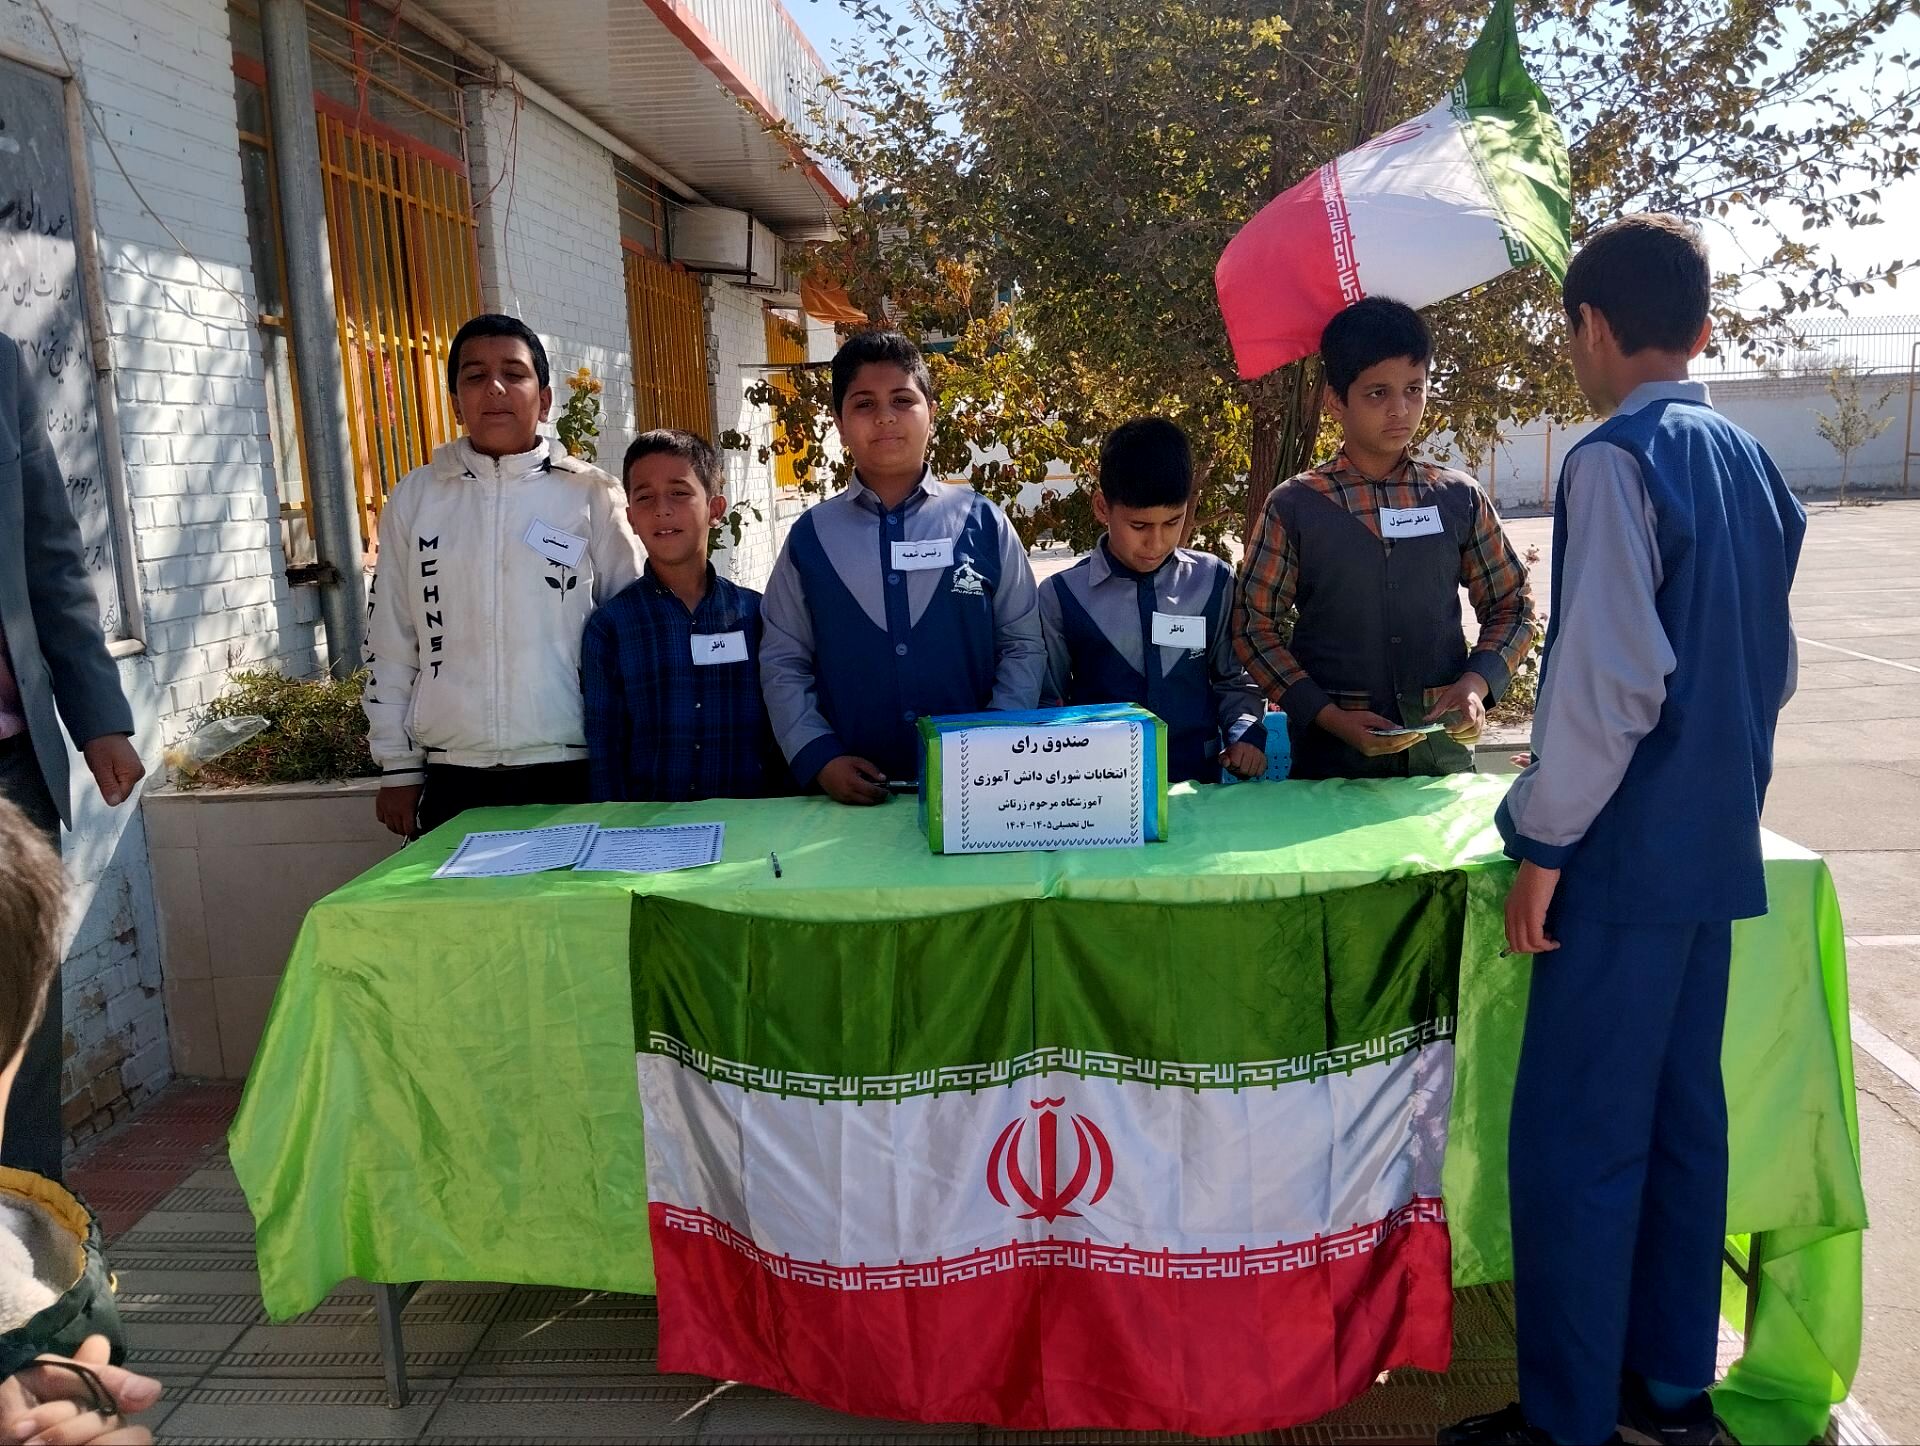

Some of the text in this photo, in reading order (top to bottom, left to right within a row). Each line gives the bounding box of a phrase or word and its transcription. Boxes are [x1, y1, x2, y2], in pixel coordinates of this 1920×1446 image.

[1413, 514, 1431, 526] ناظر
[920, 547, 942, 558] رئیس
[1168, 623, 1185, 635] ناظر
[710, 639, 726, 652] ناظر
[1011, 735, 1090, 754] صندوق رای
[973, 767, 1127, 787] انتخابات شورای دانش آموزی
[998, 796, 1103, 811] آموزشگاه مرحوم زرتاش
[1080, 821, 1095, 829] سال
